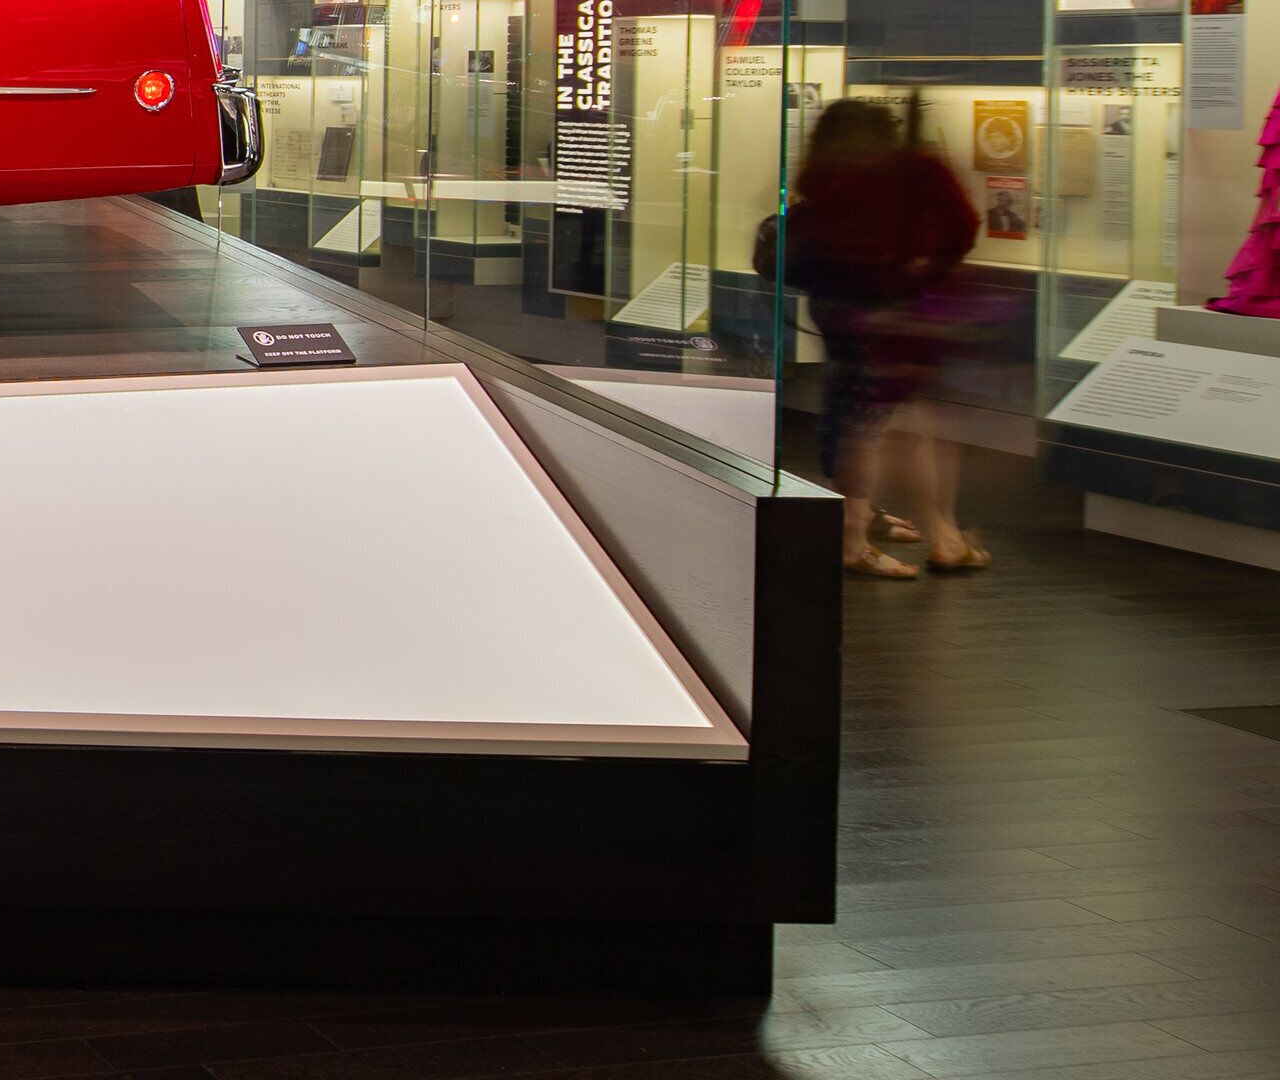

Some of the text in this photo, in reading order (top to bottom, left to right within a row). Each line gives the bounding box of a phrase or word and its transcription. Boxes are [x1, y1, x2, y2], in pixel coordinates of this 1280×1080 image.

[620, 38, 653, 46] GREENE
[726, 56, 766, 65] SAMUEL
[557, 34, 574, 110] IN THE
[1066, 71, 1153, 82] JONES, THE
[726, 79, 763, 88] TAYLOR
[1066, 87, 1182, 97] HYERS SISTERS
